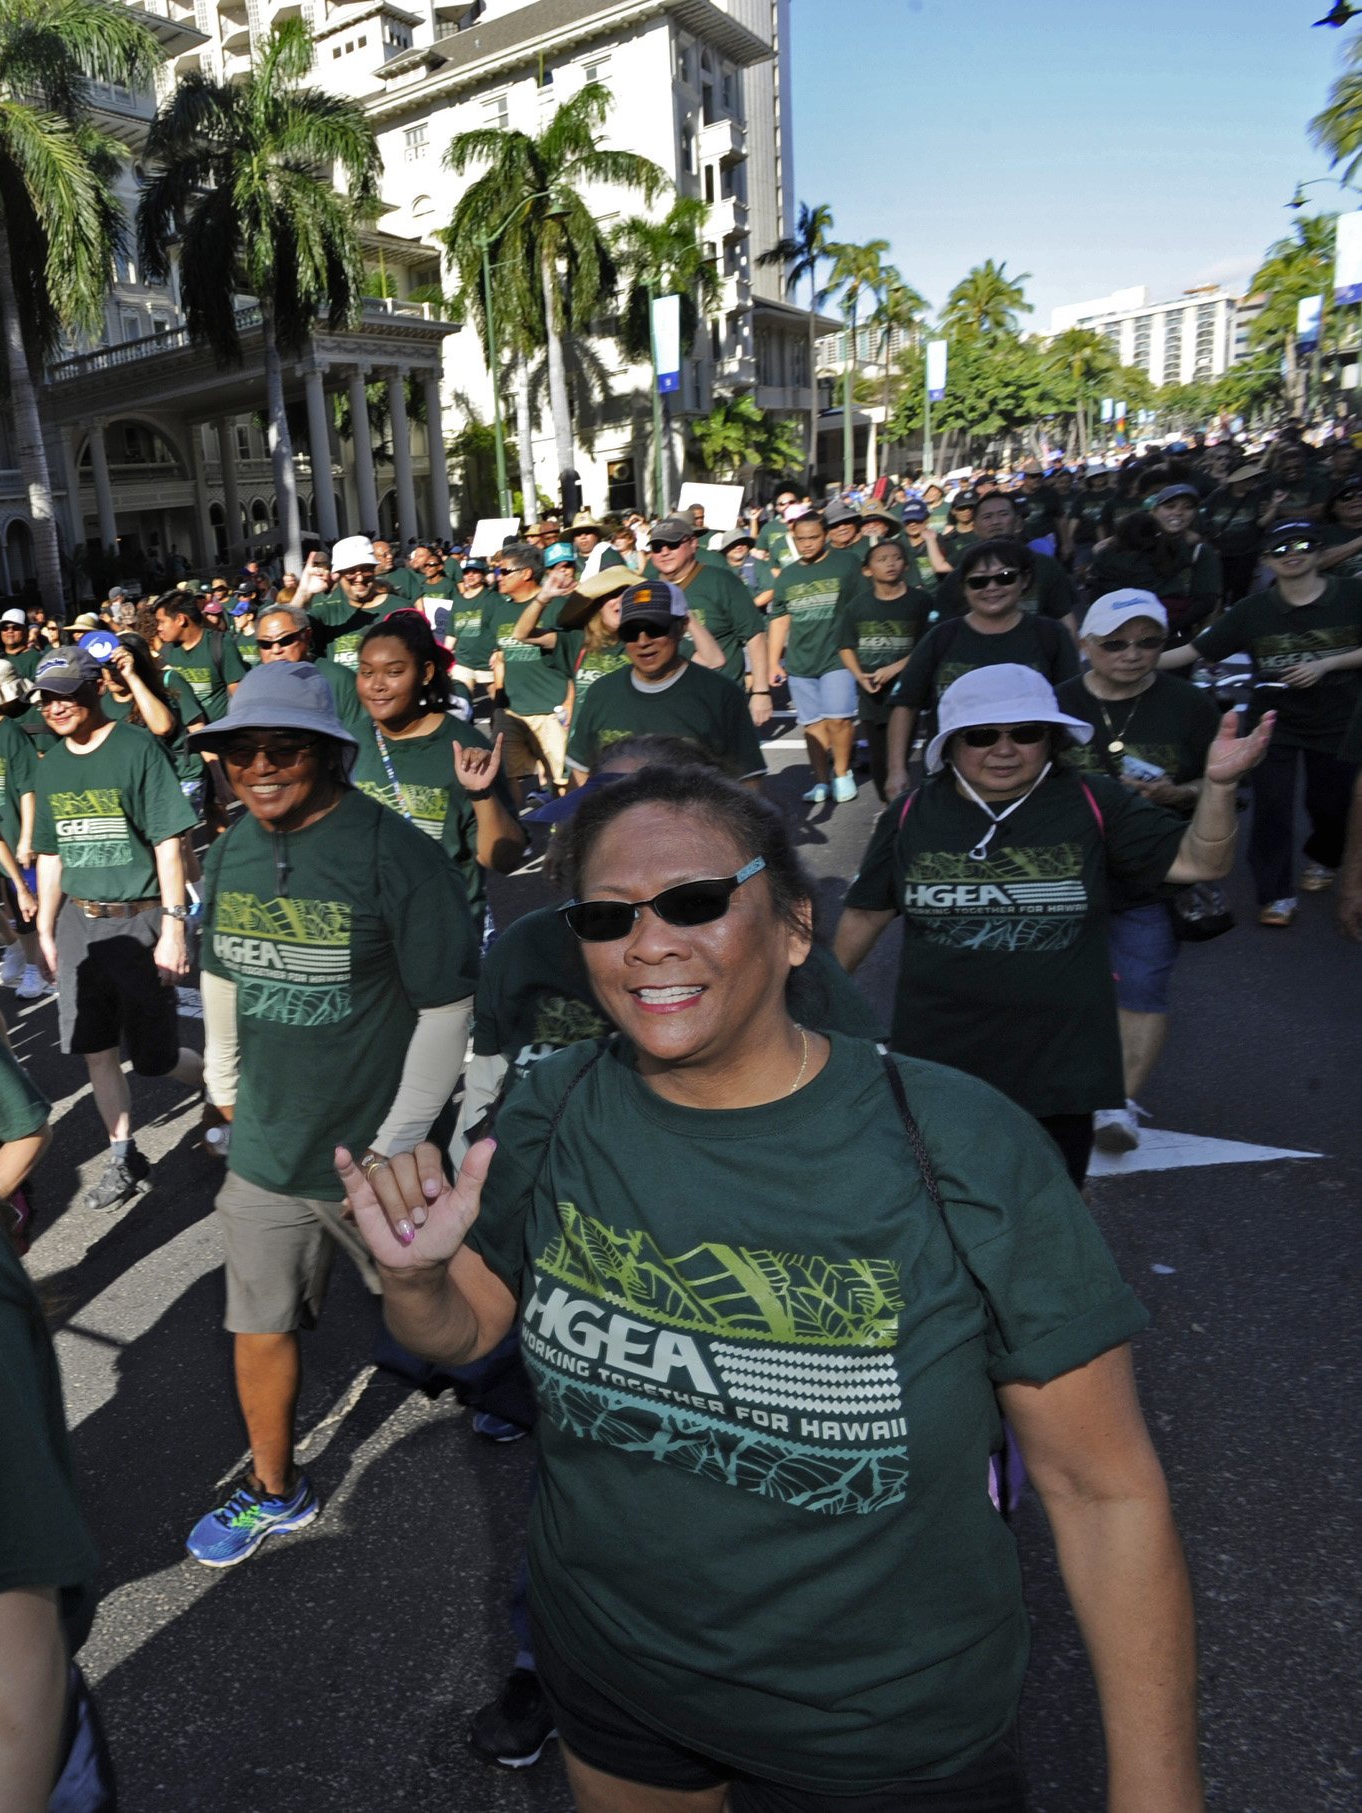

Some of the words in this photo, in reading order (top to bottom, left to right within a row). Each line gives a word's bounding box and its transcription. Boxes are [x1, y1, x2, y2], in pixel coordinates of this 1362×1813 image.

[905, 884, 1012, 907] HGEA
[954, 905, 1015, 915] TOGETHER
[1019, 905, 1044, 913] FOR
[213, 934, 286, 969] HGEA
[524, 1275, 719, 1395] HGEA
[522, 1323, 590, 1377] WORKING
[597, 1367, 727, 1415] TOGETHER
[736, 1406, 789, 1433] FOR
[800, 1417, 908, 1441] HAWAII
